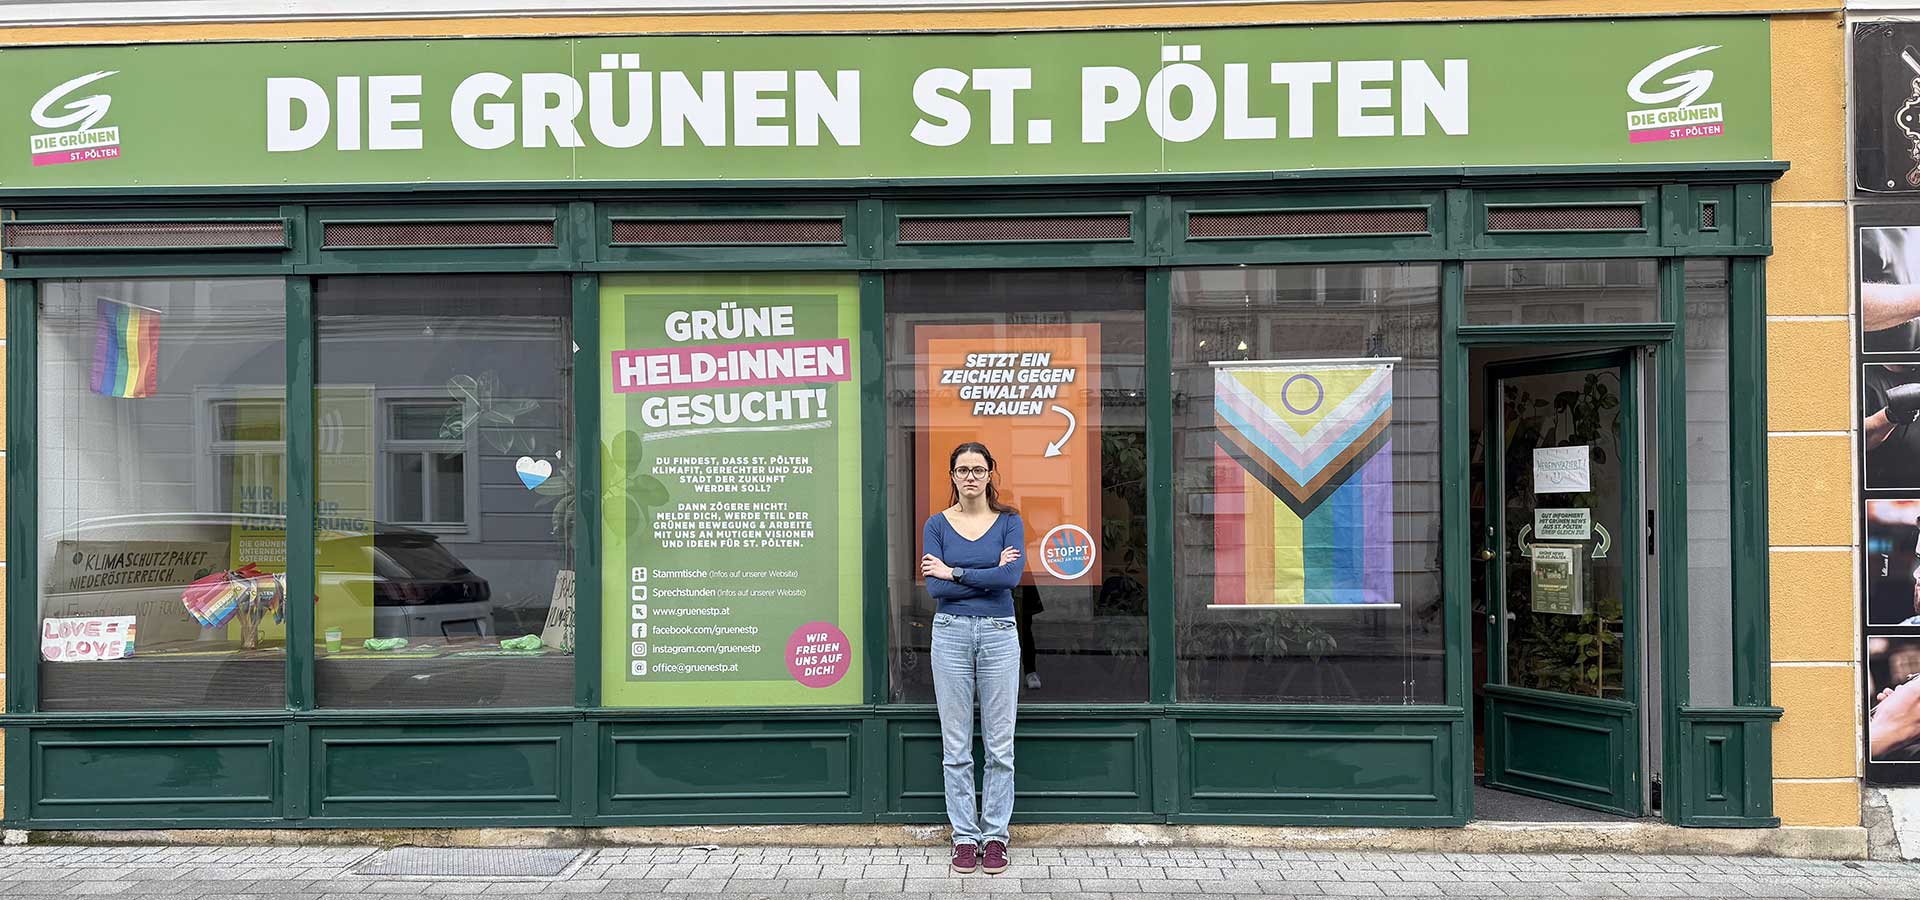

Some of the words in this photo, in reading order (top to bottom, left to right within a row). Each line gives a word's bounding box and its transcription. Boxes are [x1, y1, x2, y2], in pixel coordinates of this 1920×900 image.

[267, 74, 423, 152] DIE
[450, 53, 863, 150] GRÜNEN
[912, 68, 1051, 144] ST.
[1081, 46, 1469, 140] PÖLTEN
[1632, 114, 1655, 126] DIE
[1658, 108, 1718, 123] GRÜNEN
[1670, 130, 1683, 138] ST.
[1686, 126, 1721, 136] PÖLTEN
[35, 137, 56, 150] DIE
[60, 132, 115, 147] GRÜNEN
[71, 153, 83, 161] ST.
[85, 148, 118, 159] PÖLTEN
[664, 302, 795, 341] GRÜNE
[966, 354, 1017, 367] SETZT
[1020, 352, 1050, 367] EIN
[620, 346, 844, 387] HELD:INNEN
[940, 370, 1014, 384] ZEICHEN
[1018, 369, 1075, 383] GEGEN
[960, 386, 1028, 400] GEWALT
[1031, 385, 1057, 399] AN
[642, 388, 828, 427] GESUCHT!
[972, 401, 1043, 416] FRAUEN
[656, 456, 670, 465] DU
[674, 456, 720, 466] FINDEST,
[722, 456, 749, 465] DASS
[752, 456, 766, 465] ST.
[770, 454, 809, 465] PÖLTEN
[652, 466, 703, 475] KLIMAFIT,
[706, 466, 765, 474] GERECHTER
[768, 466, 789, 474] UND
[793, 466, 813, 474] ZUR
[679, 475, 711, 483] STADT
[715, 475, 735, 483] DER
[738, 475, 786, 483] ZUKUNFT
[241, 486, 273, 500] WIR
[694, 484, 738, 492] WERDEN
[741, 484, 771, 492] SOLL?
[241, 502, 287, 515] STEHE
[678, 502, 707, 511] DANN
[710, 501, 750, 511] ZÖGERE
[753, 502, 787, 511] NICHT!
[657, 512, 690, 520] MELDE
[694, 512, 720, 521] DICH,
[724, 512, 760, 520] WERDE
[764, 512, 785, 520] TEIL
[788, 512, 808, 520] DER
[653, 520, 695, 530] GRÜNEN
[699, 521, 756, 529] BEWEGUNG
[759, 521, 766, 529] &
[769, 521, 812, 529] ARBEITE
[654, 530, 672, 538] MIT
[675, 530, 696, 538] UNS
[699, 530, 713, 538] AN
[716, 530, 761, 538] MUTIGEN
[764, 530, 814, 538] VISIONEN
[662, 539, 684, 548] UND
[687, 539, 717, 548] IDEEN
[720, 538, 740, 548] FÜR
[743, 539, 758, 548] ST.
[761, 538, 803, 548] PÖLTEN.
[1047, 546, 1088, 558] STOPPT
[85, 550, 208, 571] KLIMASCHUTZPAKET
[69, 568, 186, 590] NIEDERÖSTERREICH...
[652, 569, 707, 579] Stammtische
[709, 570, 728, 579] (Infos
[729, 570, 740, 579] auf
[768, 570, 799, 579] Website)
[652, 588, 716, 598] Sprechstunden
[717, 588, 737, 598] (Infos
[737, 588, 749, 597] auf
[776, 588, 806, 598] Website)
[652, 608, 730, 616] www.gruenestp.at
[44, 622, 100, 639] LOVE
[652, 625, 758, 635] facebook.com/gruenestp
[806, 633, 828, 643] WIR
[66, 640, 121, 657] LOVE
[652, 644, 761, 654] instagram.com/gruenestp
[796, 643, 840, 655] FREUEN
[795, 656, 818, 666] UNS
[820, 654, 842, 664] AUF
[652, 663, 739, 673] office@gruenestp.at
[804, 666, 834, 676] DICH!
